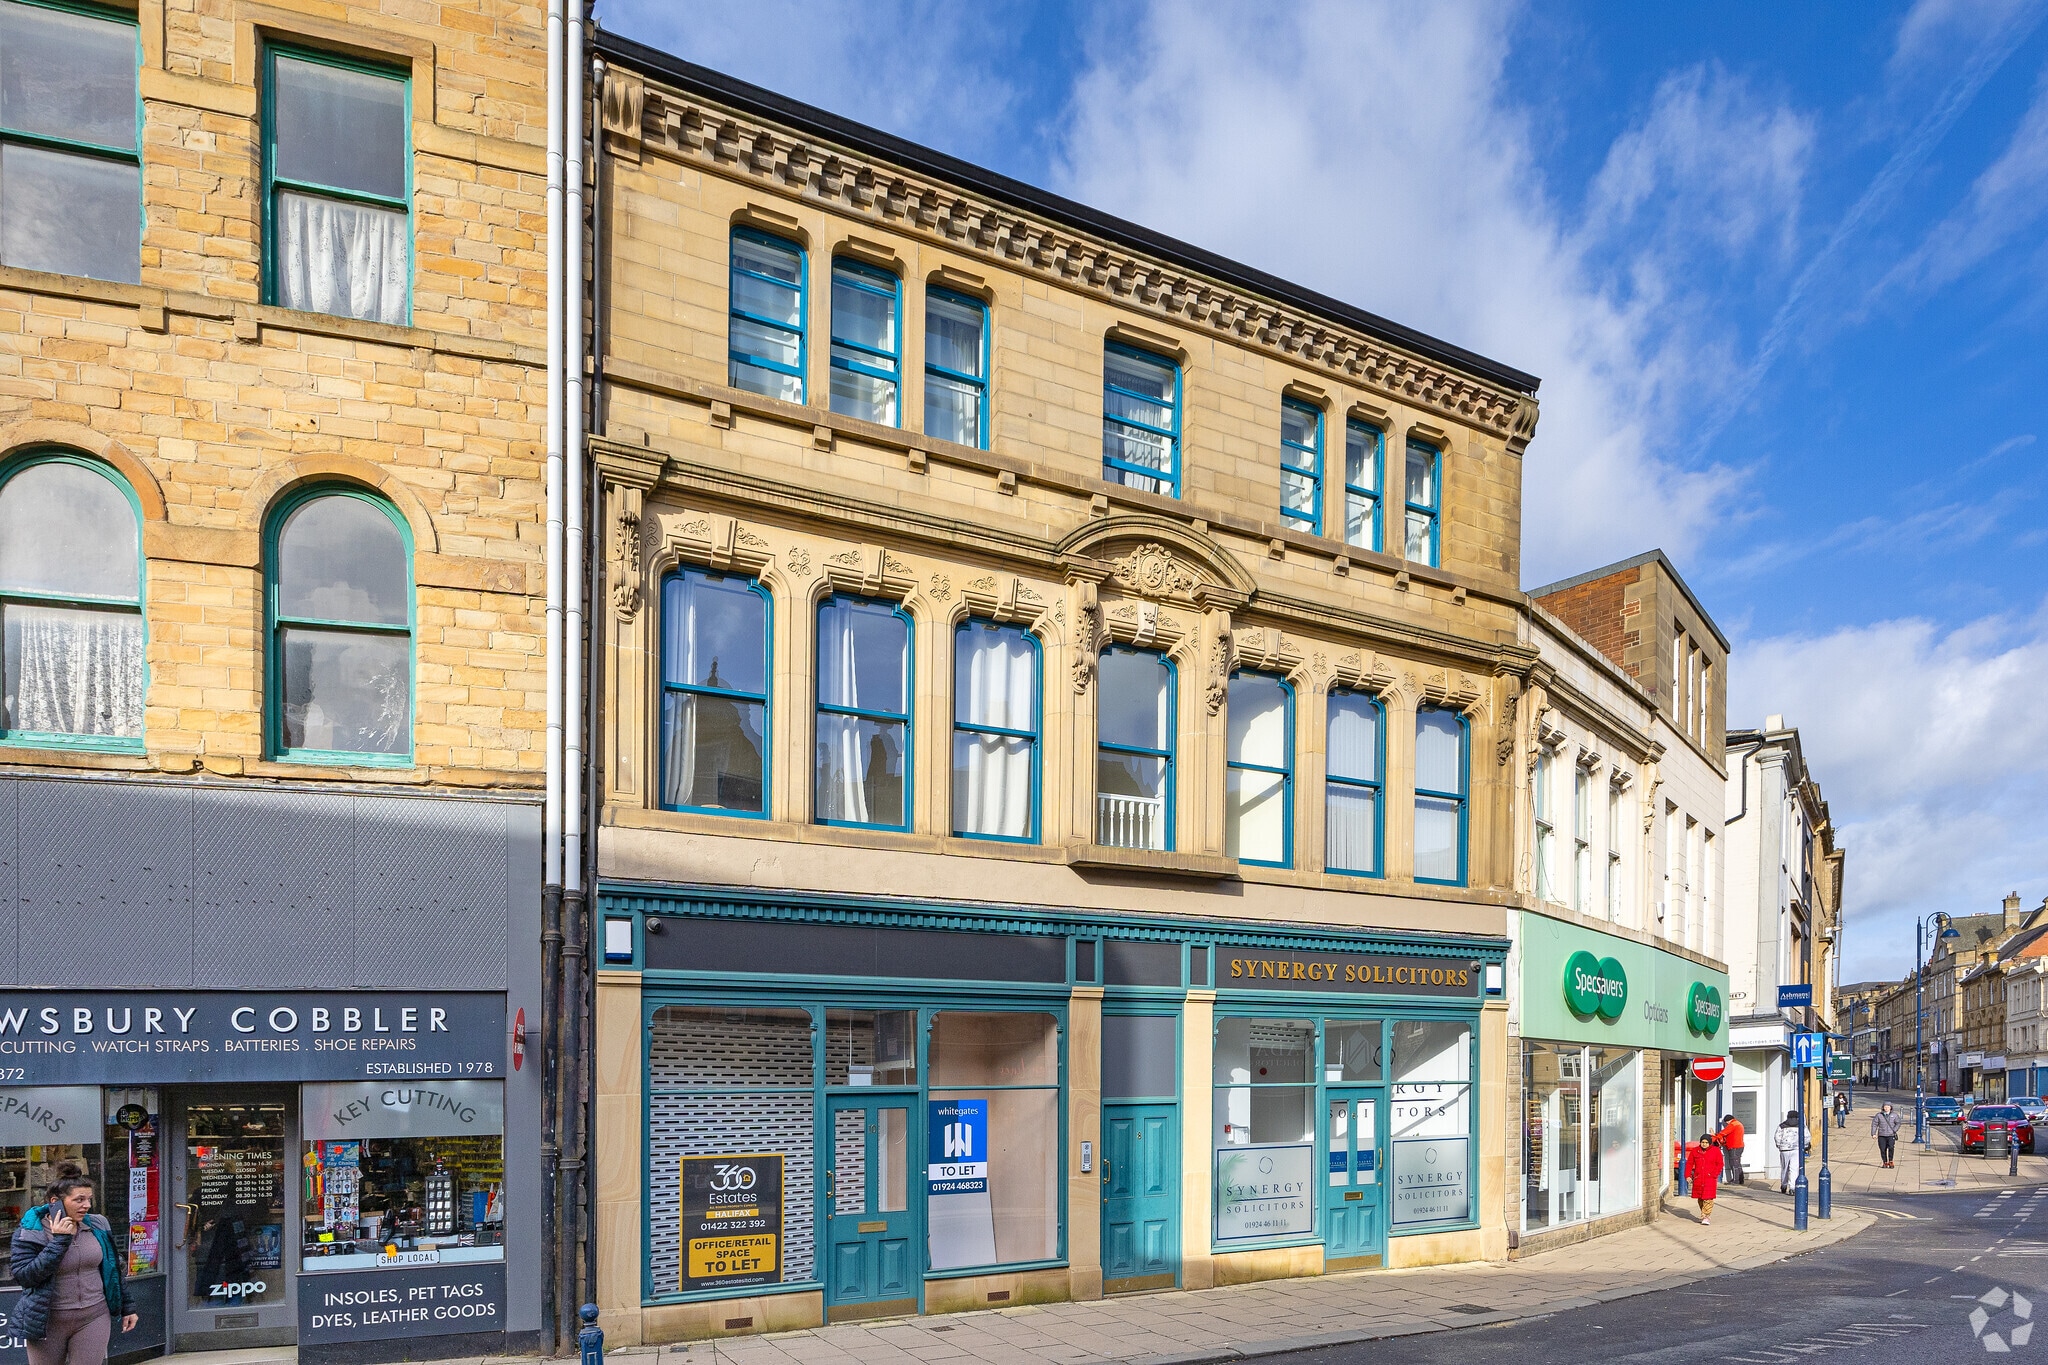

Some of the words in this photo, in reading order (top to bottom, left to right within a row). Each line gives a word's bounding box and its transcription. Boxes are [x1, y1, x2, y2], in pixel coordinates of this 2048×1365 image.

[1231, 958, 1338, 982] SYNERGY
[1345, 964, 1469, 987] SOLICITORS
[1575, 967, 1624, 998] Specsavers
[1643, 1000, 1669, 1024] Opticians
[1694, 994, 1720, 1019] Specsavers
[0, 1007, 197, 1034] WSBURY
[231, 1006, 450, 1033] COBBLER
[0, 1040, 76, 1054] CUTTING
[91, 1040, 149, 1053] WATCH
[155, 1039, 210, 1053] STRAPS
[225, 1038, 300, 1052] BATTERIES
[314, 1038, 357, 1051] SHOE
[362, 1038, 416, 1051] REPAIRS
[366, 1062, 452, 1075] ESTABLISHED
[457, 1062, 493, 1074] 1978
[333, 1095, 371, 1127] KEY
[380, 1089, 477, 1124] CUTTING
[937, 1107, 979, 1117] whitegates
[201, 1153, 244, 1161] OPENING
[246, 1151, 272, 1160] TIMES
[709, 1164, 757, 1191] 360
[940, 1166, 956, 1177] TO
[958, 1165, 976, 1176] LET
[1398, 1171, 1463, 1185] SYNERGY
[932, 1182, 956, 1192] 01924
[956, 1181, 984, 1191] 468323
[1226, 1182, 1304, 1197] SYNERGY
[709, 1192, 757, 1205] Estates
[1398, 1188, 1463, 1200] SOLICITORS
[714, 1209, 751, 1218] HALIFAX
[1226, 1201, 1304, 1214] SOLICITORS
[700, 1221, 728, 1231] 01422
[730, 1220, 747, 1229] 322
[749, 1219, 766, 1228] 392
[1244, 1221, 1262, 1229] 01924
[1263, 1220, 1271, 1228] 46
[694, 1237, 772, 1250] OFFICE/RETAIL
[381, 1255, 404, 1264] SHOP
[407, 1253, 435, 1263] LOCAL
[716, 1249, 750, 1259] SPACE
[704, 1260, 727, 1273] TO
[732, 1258, 761, 1272] LET
[209, 1281, 267, 1298] zippo
[324, 1289, 403, 1306] INSOLES,
[408, 1286, 437, 1300] PET
[441, 1283, 484, 1298] TAGS
[312, 1313, 357, 1329] DYES,
[362, 1308, 430, 1325] LEATHER
[434, 1302, 496, 1320] GOODS
